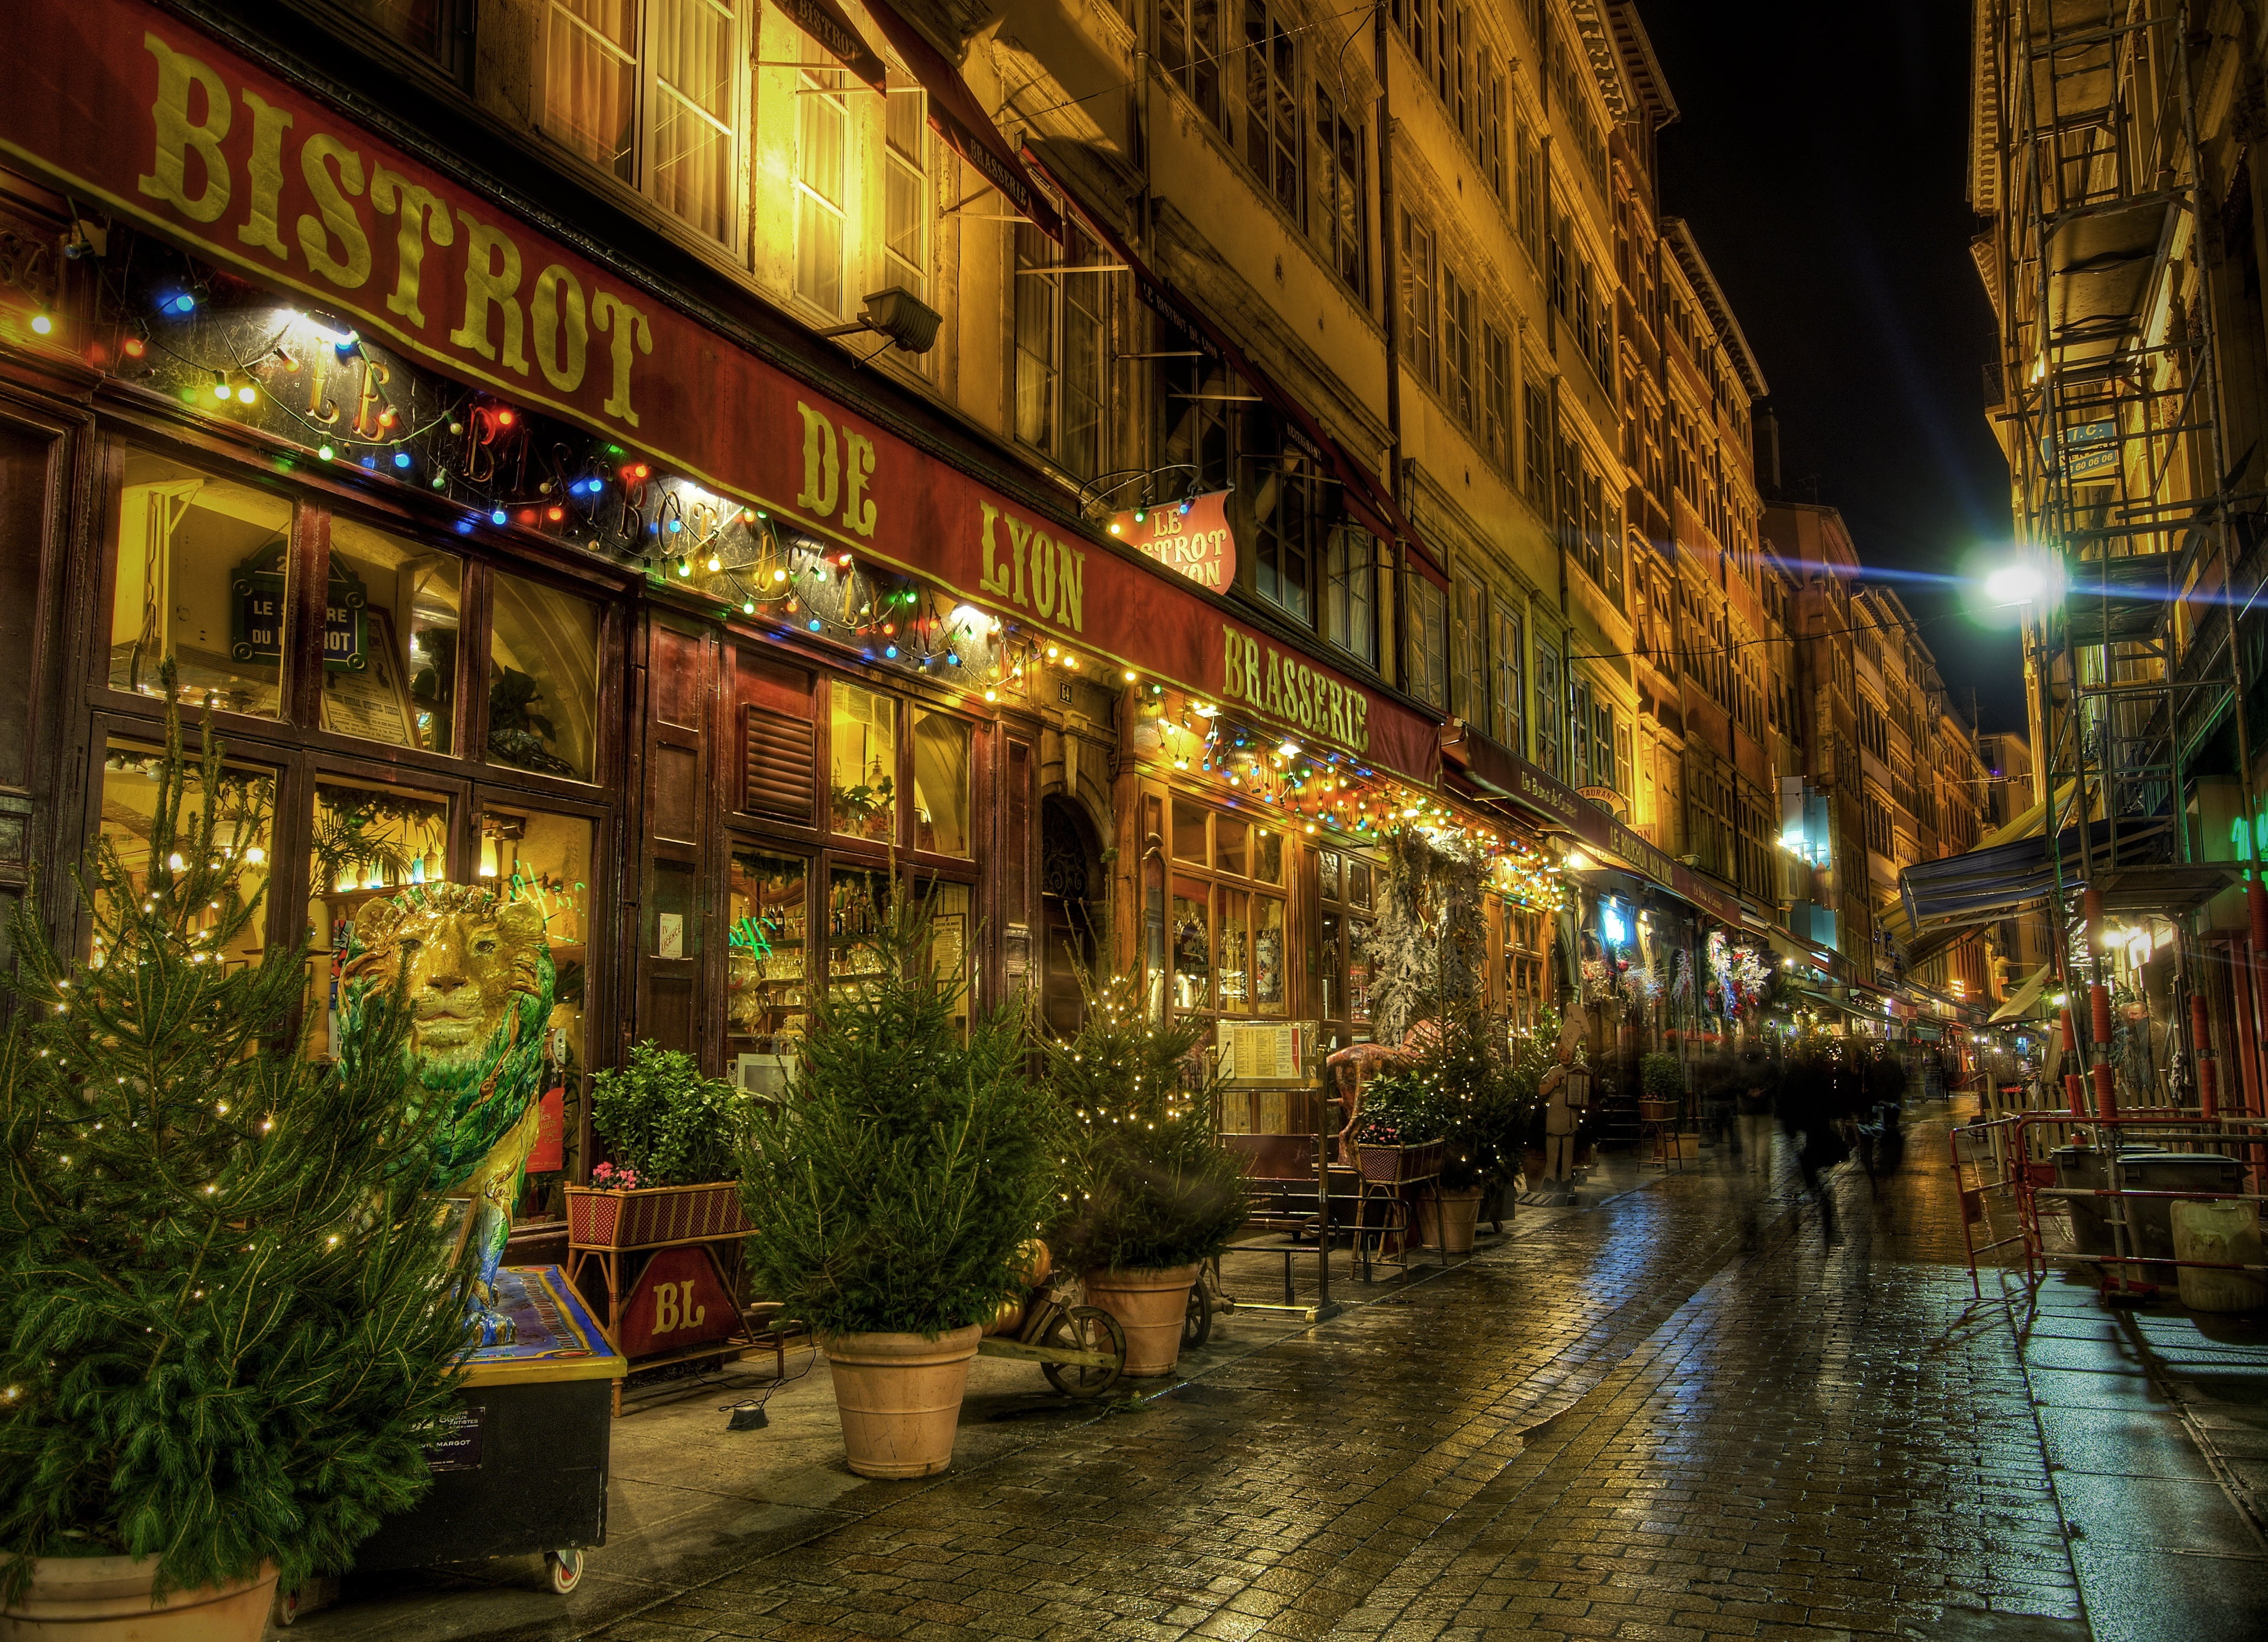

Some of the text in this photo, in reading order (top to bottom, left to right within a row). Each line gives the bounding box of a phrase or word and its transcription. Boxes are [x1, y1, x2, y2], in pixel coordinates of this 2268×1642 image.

[798, 0, 858, 64] BISTROT
[970, 138, 1026, 206] BRASSERIE
[138, 31, 1085, 632] BISTROT DE LYON
[304, 336, 391, 441] LE
[462, 403, 717, 568] BISTROT
[1287, 422, 1321, 462] RESTAURANT
[2075, 461, 2086, 471] 60
[2088, 457, 2099, 467] 06
[2102, 453, 2113, 463] 06
[1153, 508, 1182, 538] LE
[1139, 529, 1227, 565] STROT
[1173, 560, 1221, 587] ON
[254, 600, 273, 616] LE
[252, 629, 271, 644] DU
[1062, 684, 1070, 701] 64
[1223, 624, 1369, 753] BRASSERIE
[1581, 789, 1616, 801] TAURANT
[1610, 826, 1673, 887] LE BOUCHON AUX VINS
[662, 924, 682, 951] LICENCE
[652, 1279, 705, 1335] BL
